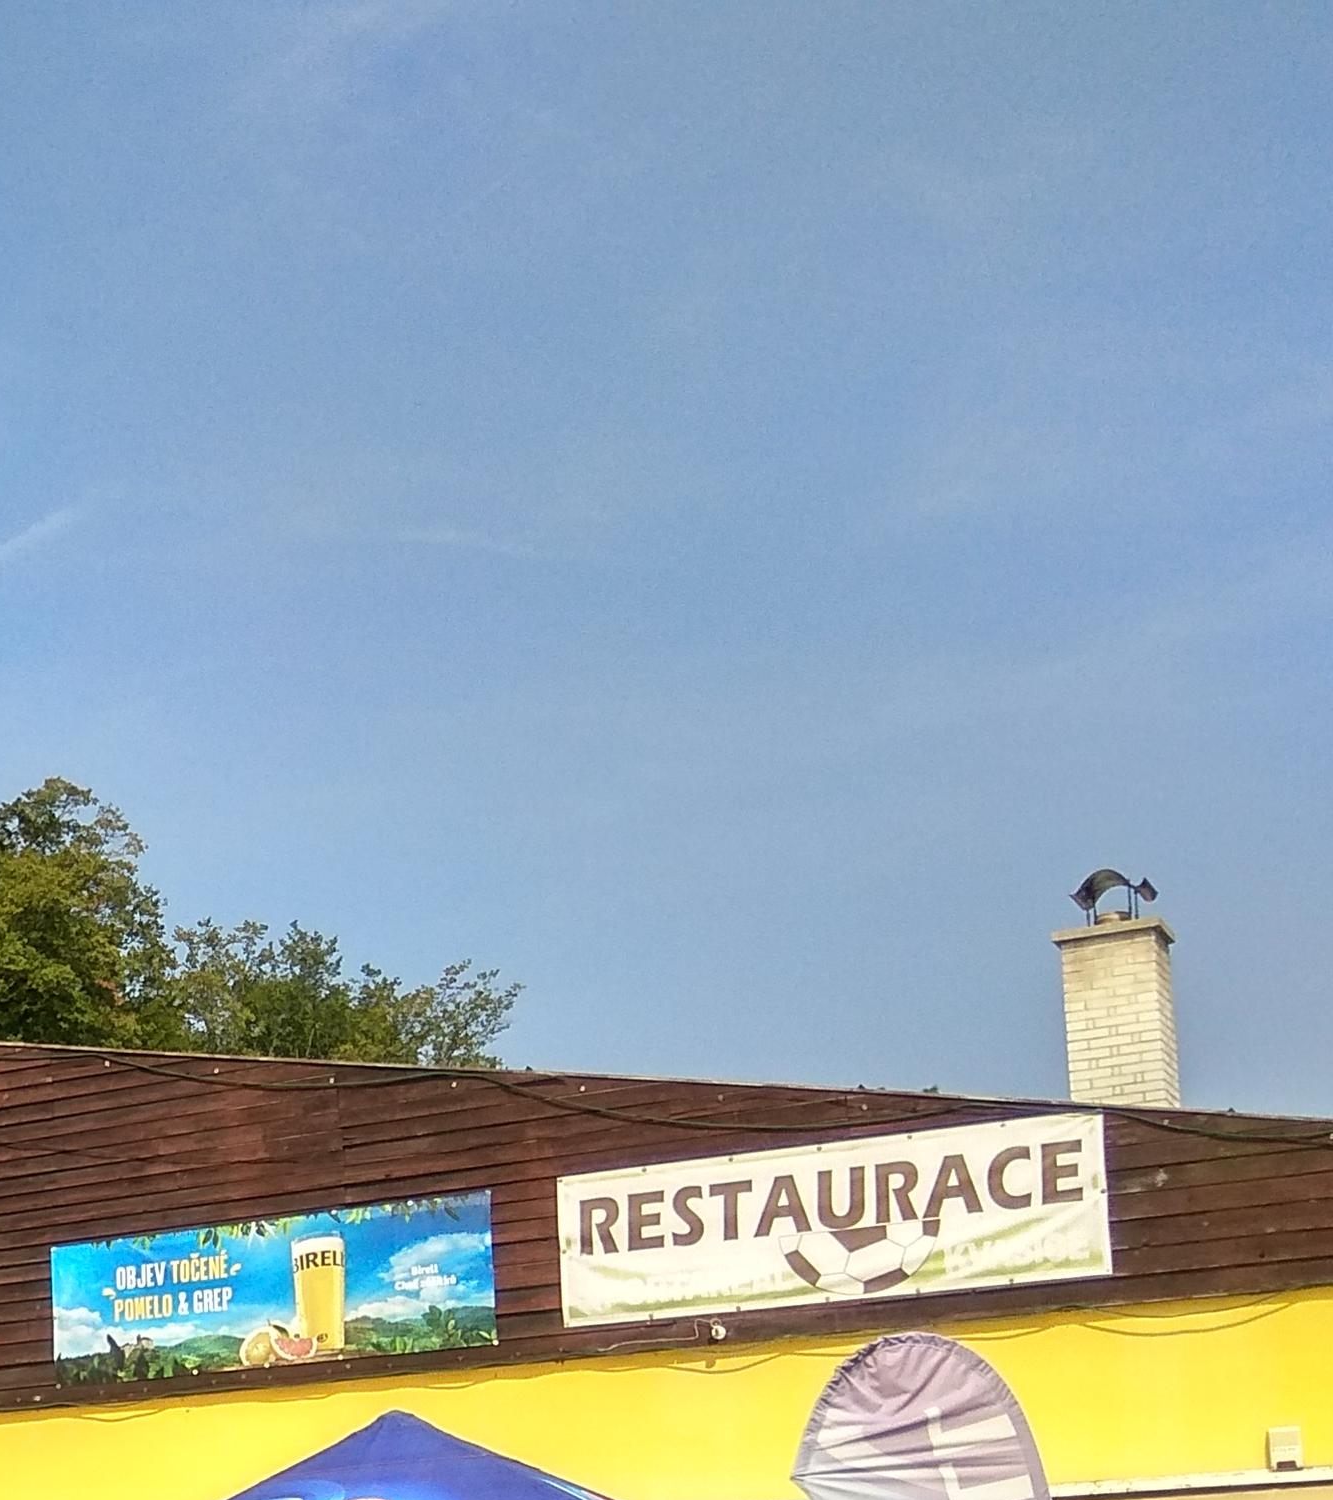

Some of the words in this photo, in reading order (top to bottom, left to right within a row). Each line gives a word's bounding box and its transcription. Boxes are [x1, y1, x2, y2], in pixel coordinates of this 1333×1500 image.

[579, 1139, 1084, 1256] RESTAURACE
[115, 1261, 167, 1291] OBJEV
[170, 1248, 229, 1284] TOČENÉ
[113, 1293, 173, 1322] POMELO
[177, 1291, 190, 1316] &
[192, 1286, 233, 1315] GREP
